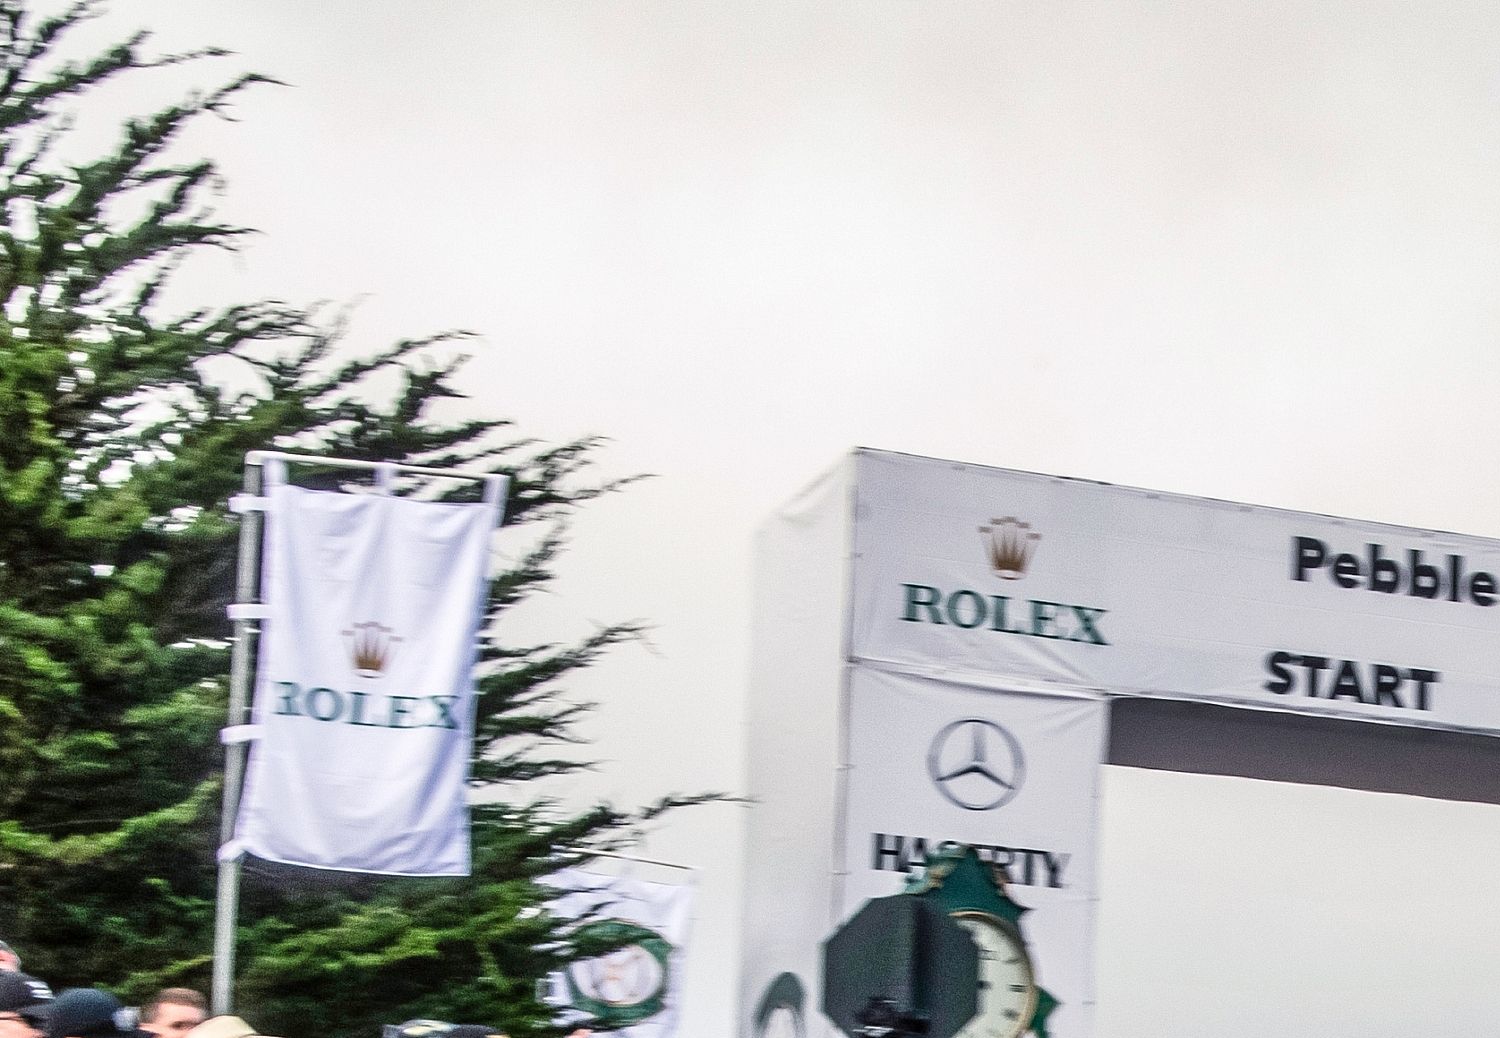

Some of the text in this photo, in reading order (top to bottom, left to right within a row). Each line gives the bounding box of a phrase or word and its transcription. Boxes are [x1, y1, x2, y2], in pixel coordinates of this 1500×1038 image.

[1291, 535, 1499, 607] Pebble
[899, 583, 1110, 646] ROLEX
[273, 680, 460, 731] ROLEX
[1264, 650, 1441, 711] START
[871, 832, 1071, 889] HARTY
